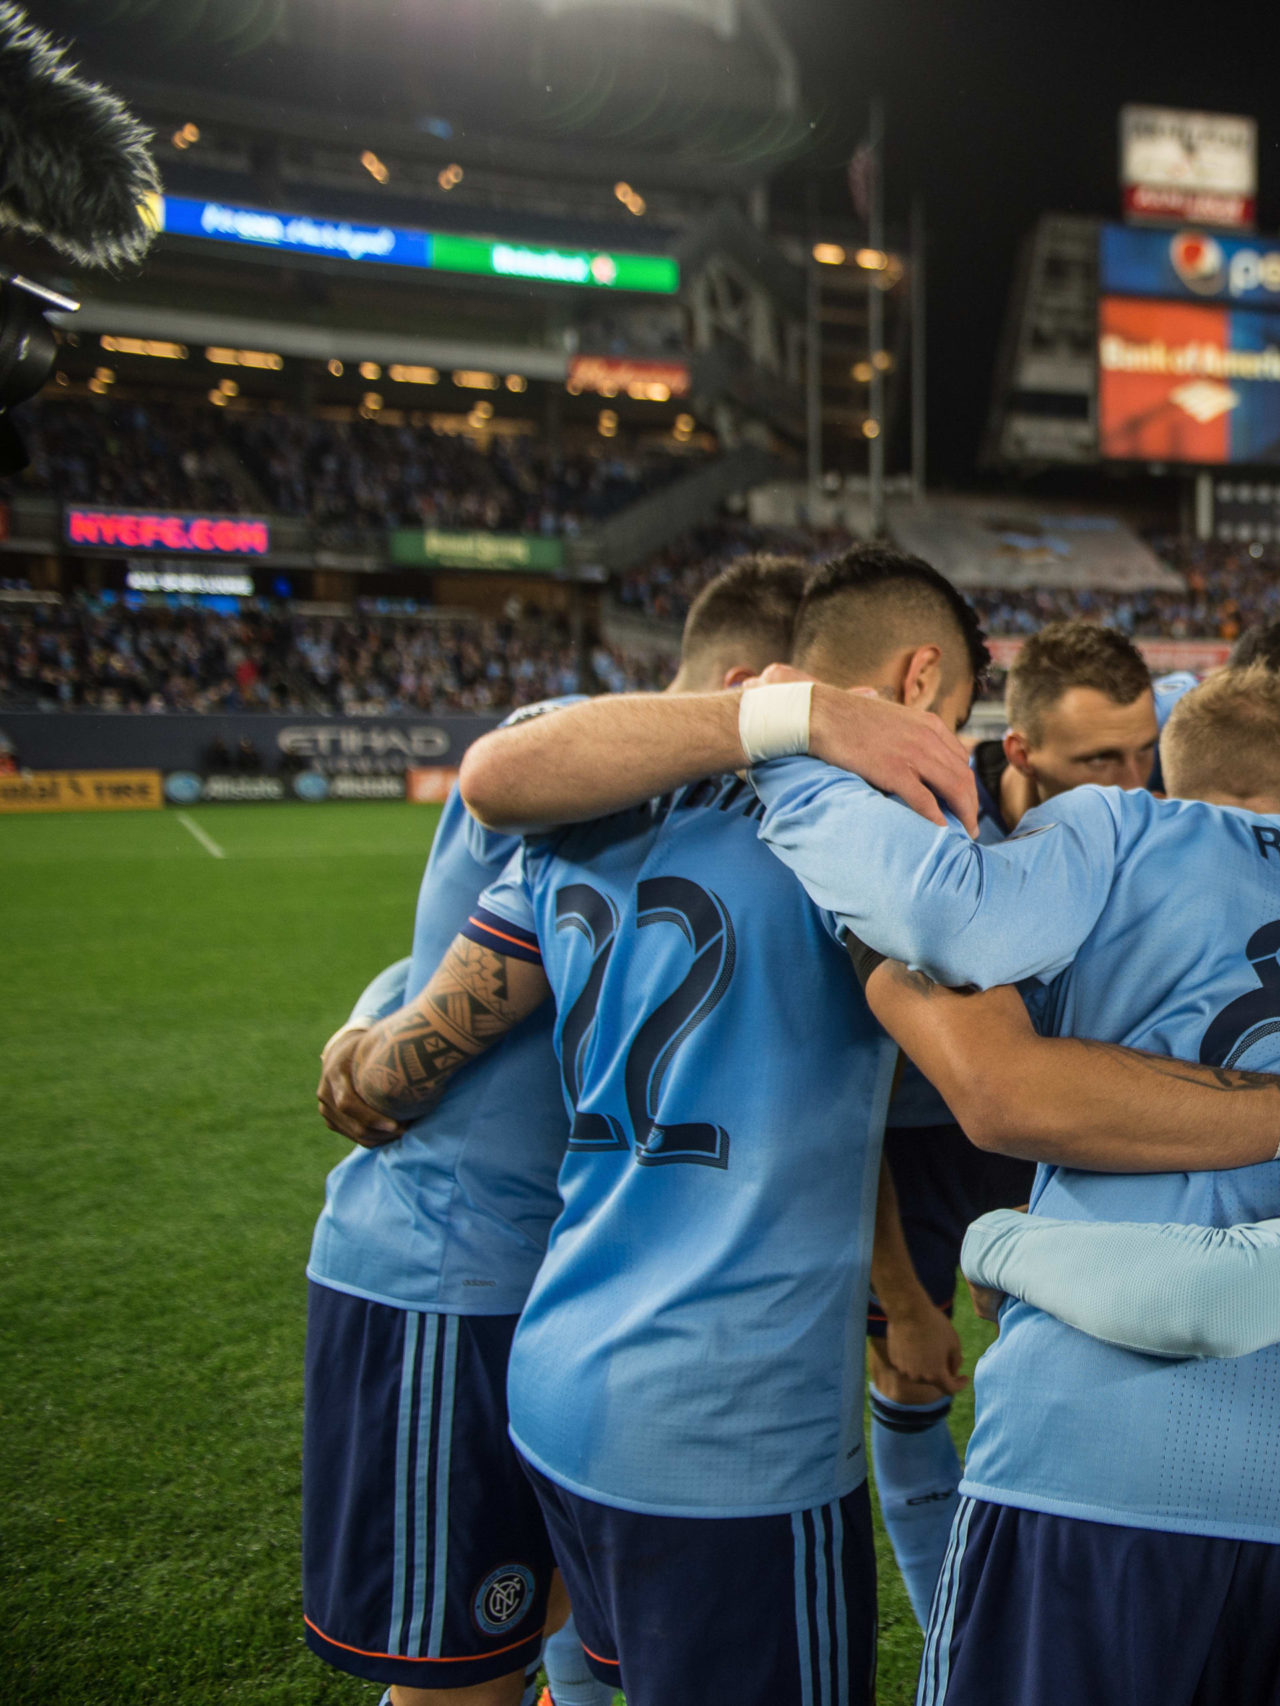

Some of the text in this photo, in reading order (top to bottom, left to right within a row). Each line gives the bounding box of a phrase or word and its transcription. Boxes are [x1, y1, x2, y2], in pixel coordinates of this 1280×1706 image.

[1100, 334, 1171, 372] Bank
[277, 726, 449, 757] ETIHAD
[555, 876, 737, 1170] 22
